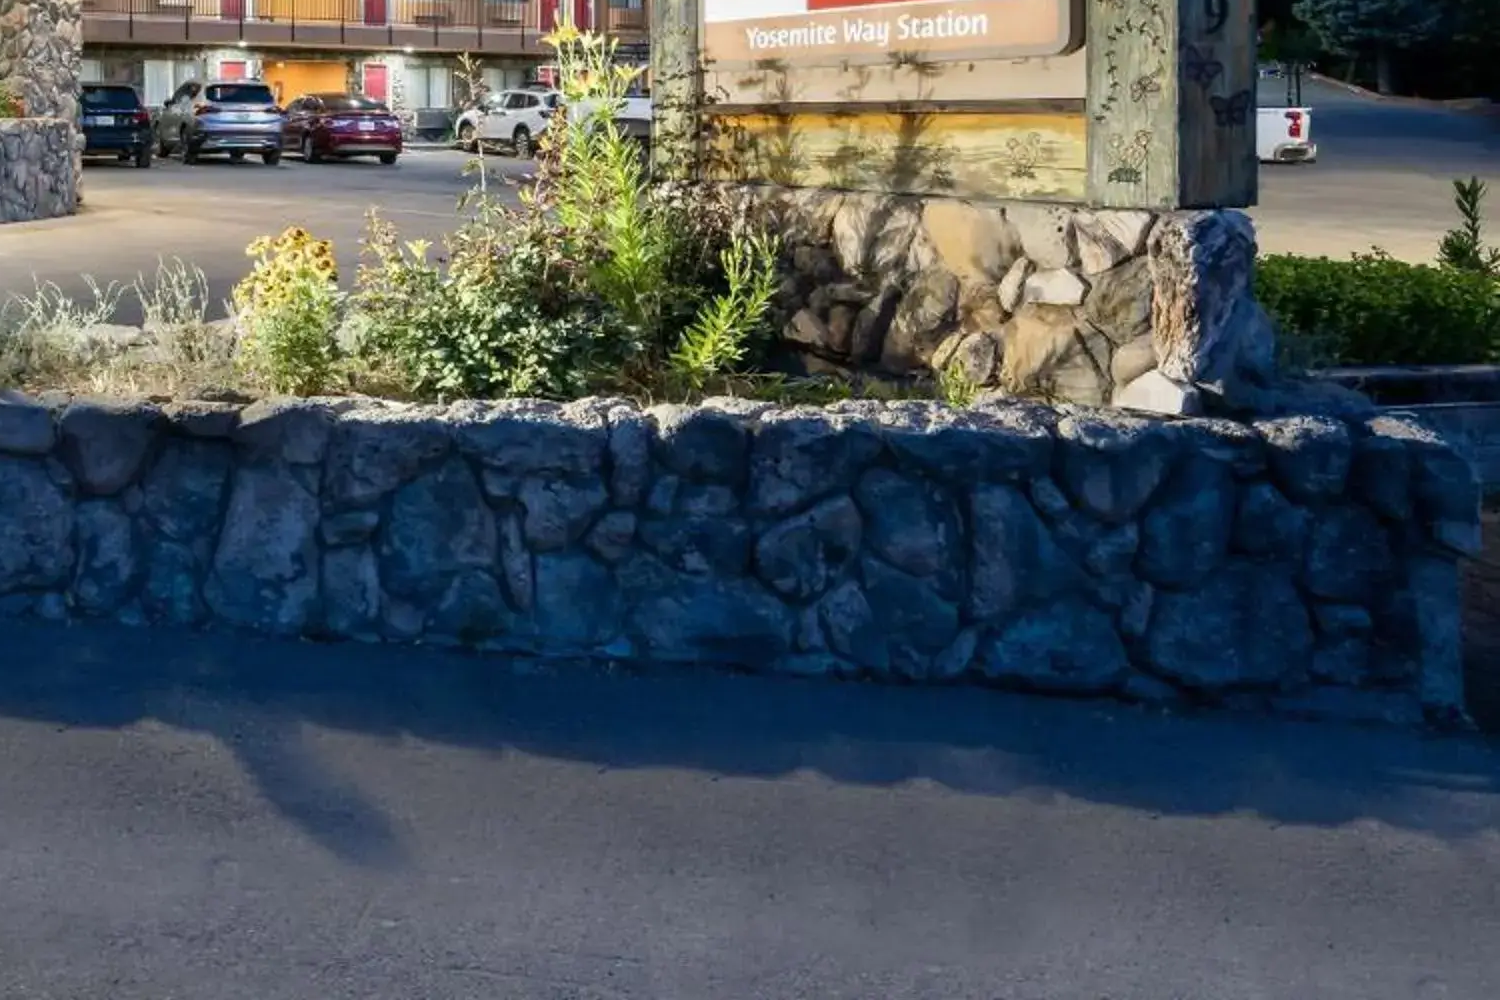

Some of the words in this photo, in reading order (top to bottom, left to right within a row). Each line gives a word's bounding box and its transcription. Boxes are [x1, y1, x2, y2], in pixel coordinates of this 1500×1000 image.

[746, 21, 837, 49] Yosemite
[843, 18, 891, 46] Way
[897, 9, 988, 40] Station
